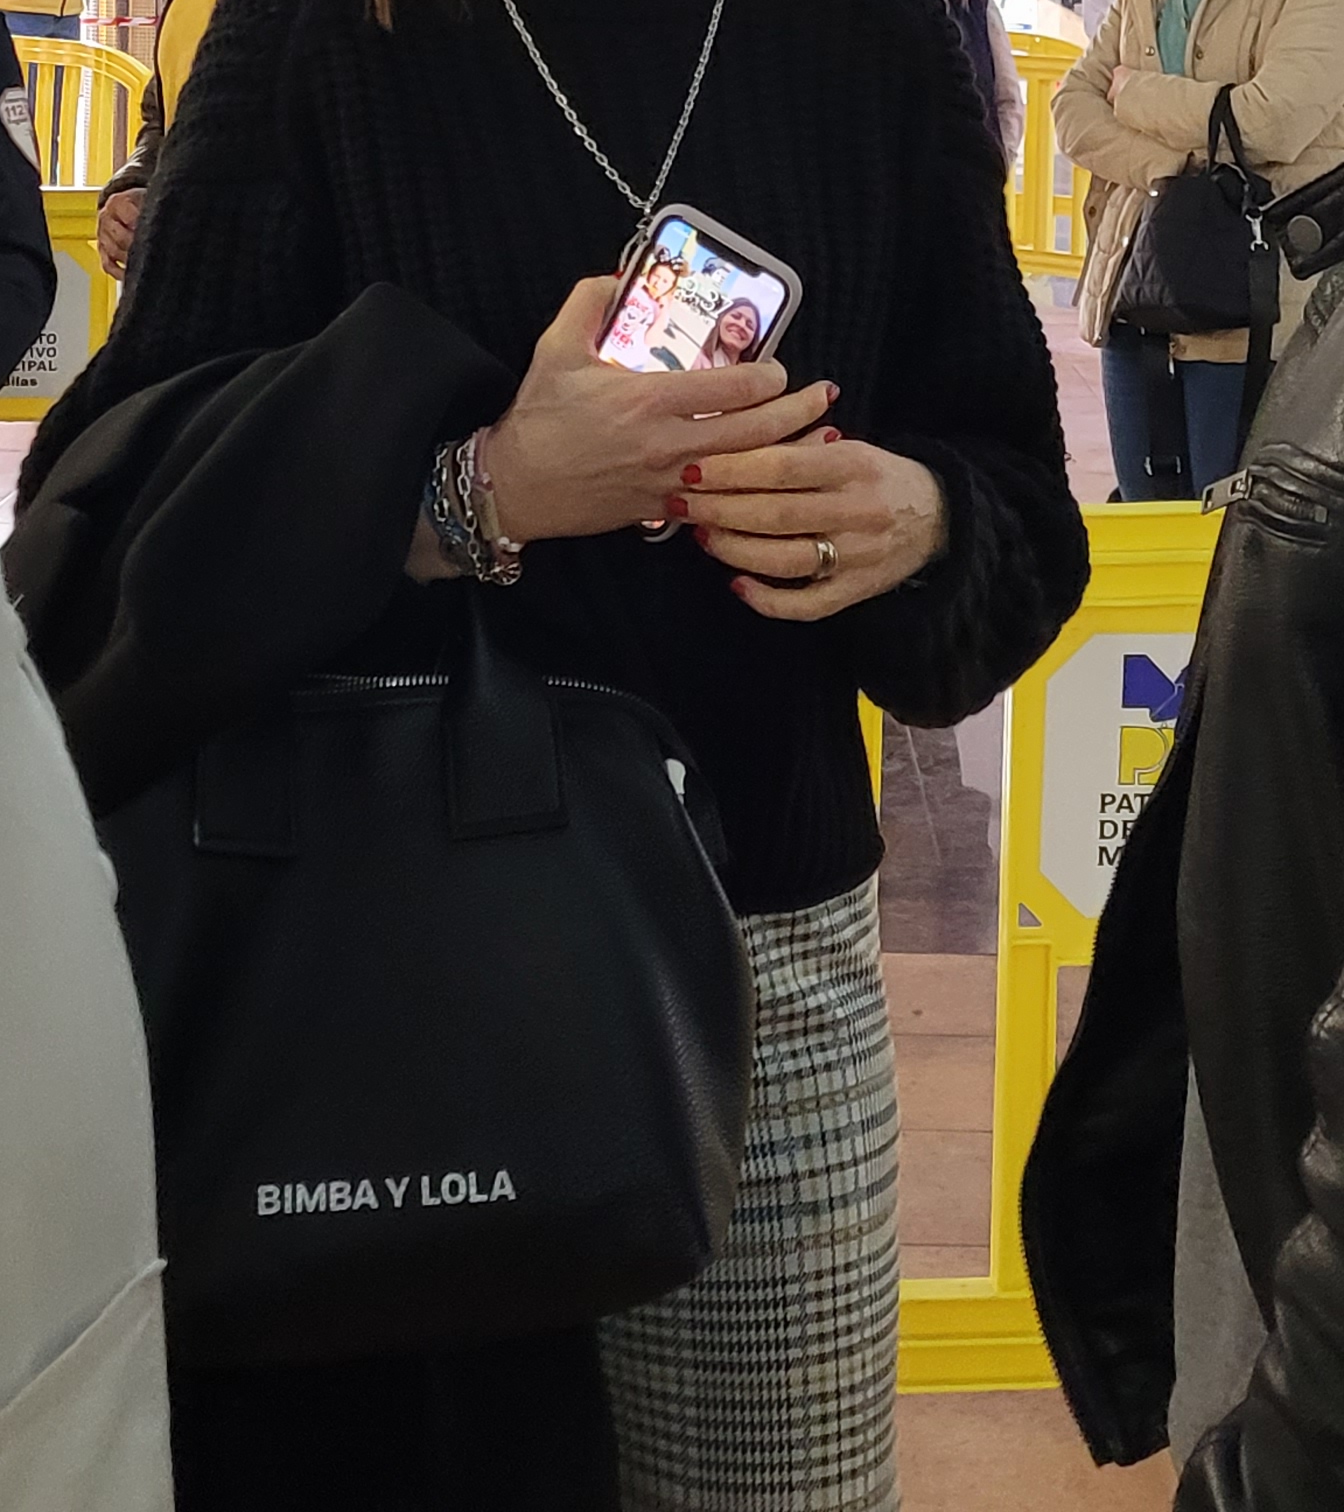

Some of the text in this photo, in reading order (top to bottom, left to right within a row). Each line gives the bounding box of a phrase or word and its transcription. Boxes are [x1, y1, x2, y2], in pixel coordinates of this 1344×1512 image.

[257, 1170, 517, 1215] BIMBA Y LOLA
